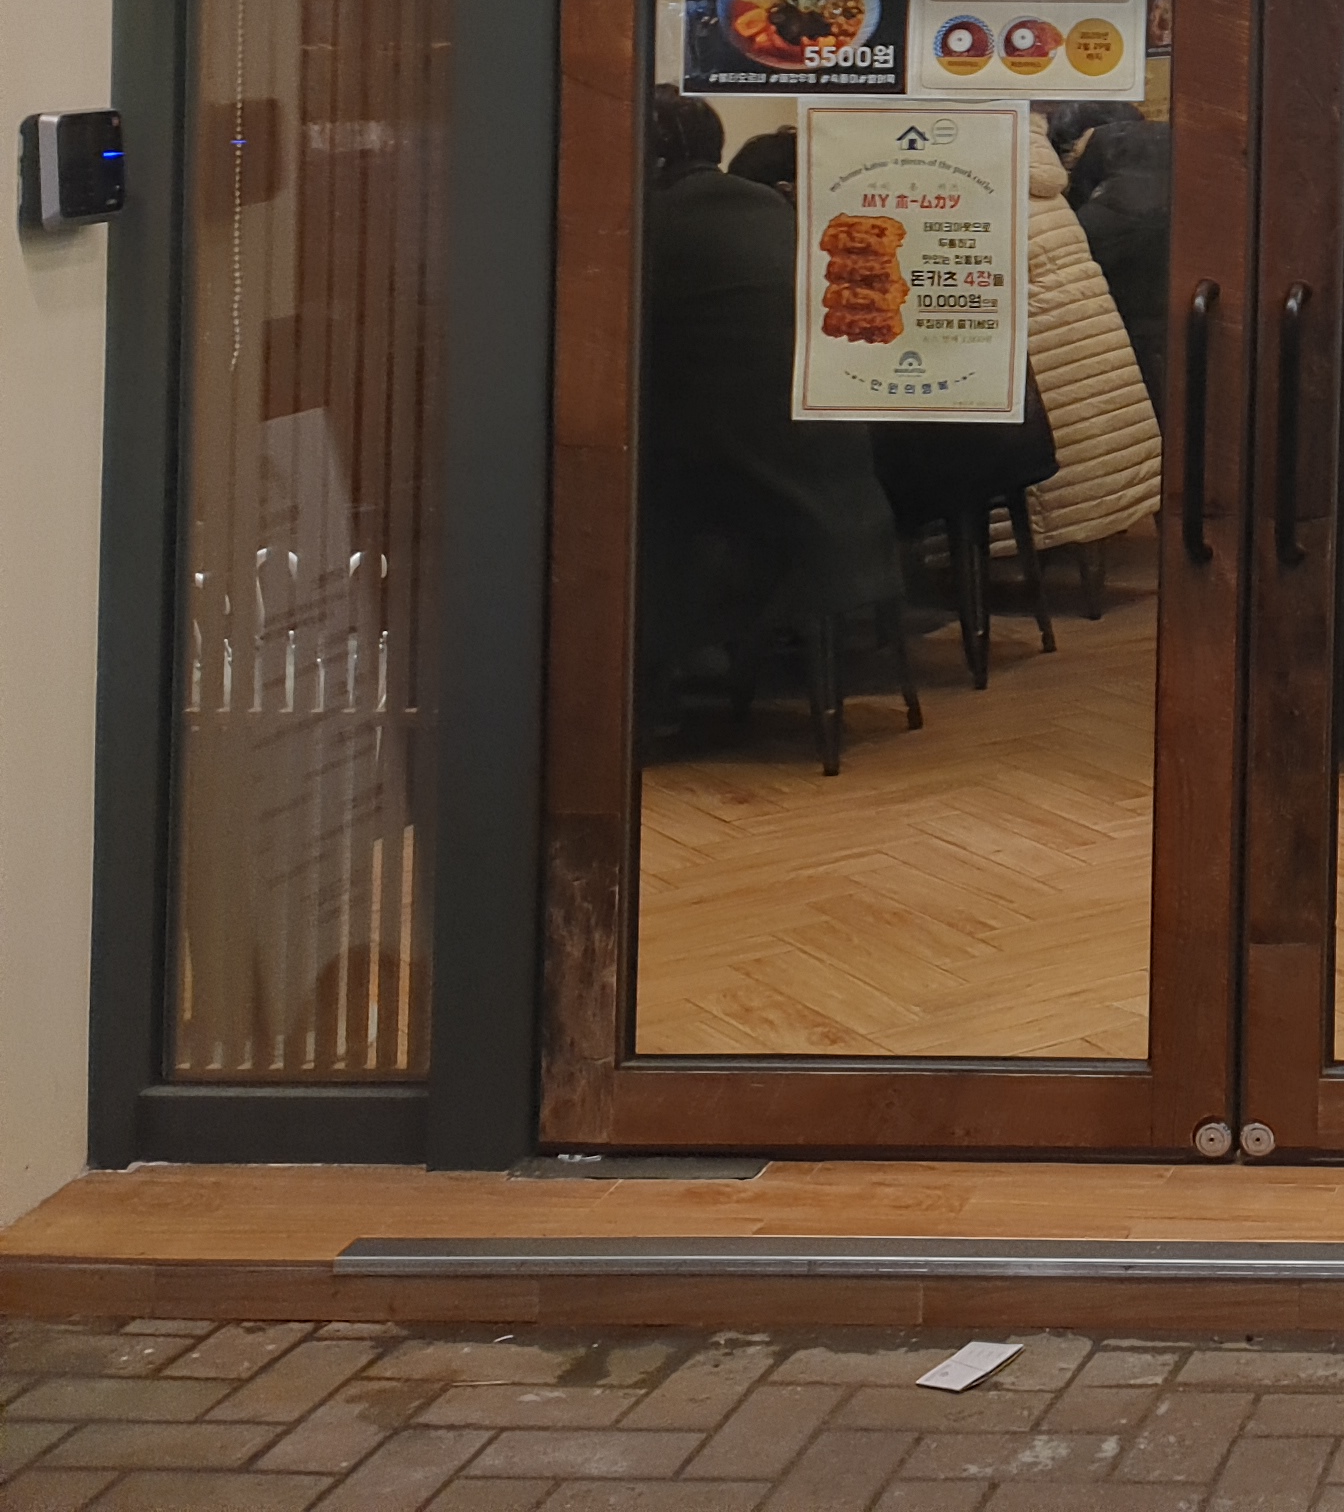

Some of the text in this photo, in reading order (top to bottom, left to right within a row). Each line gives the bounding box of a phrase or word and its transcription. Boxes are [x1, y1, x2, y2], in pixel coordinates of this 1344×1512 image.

[804, 45, 894, 68] 5500원
[862, 194, 962, 209] MY ホームカツ
[911, 270, 958, 287] 돈카츠
